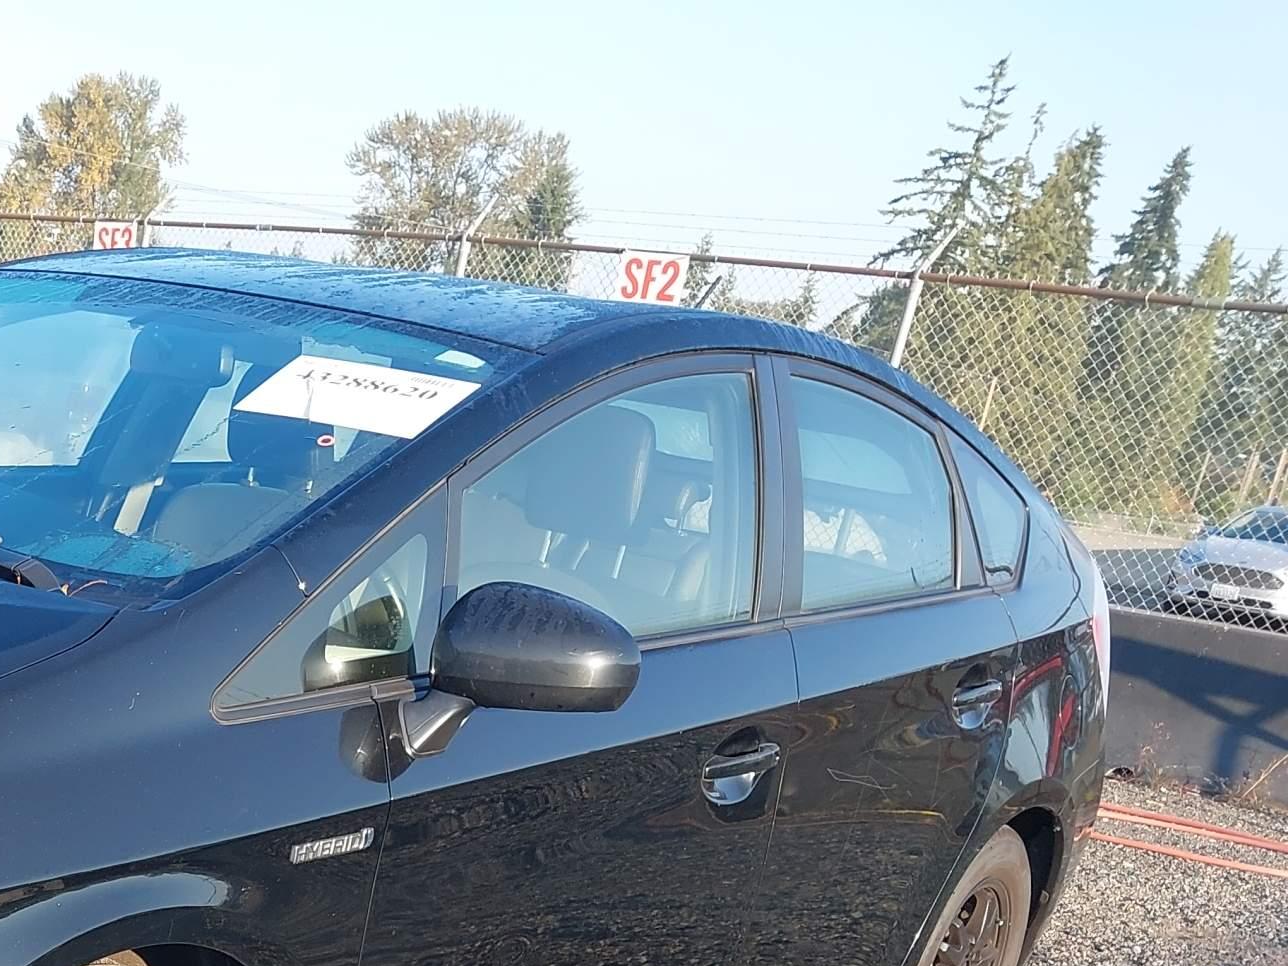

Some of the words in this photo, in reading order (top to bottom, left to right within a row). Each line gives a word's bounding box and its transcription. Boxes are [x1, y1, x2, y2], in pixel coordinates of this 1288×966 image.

[621, 257, 680, 302] SF2
[296, 369, 438, 400] 43288620
[289, 826, 375, 865] HYBRID
